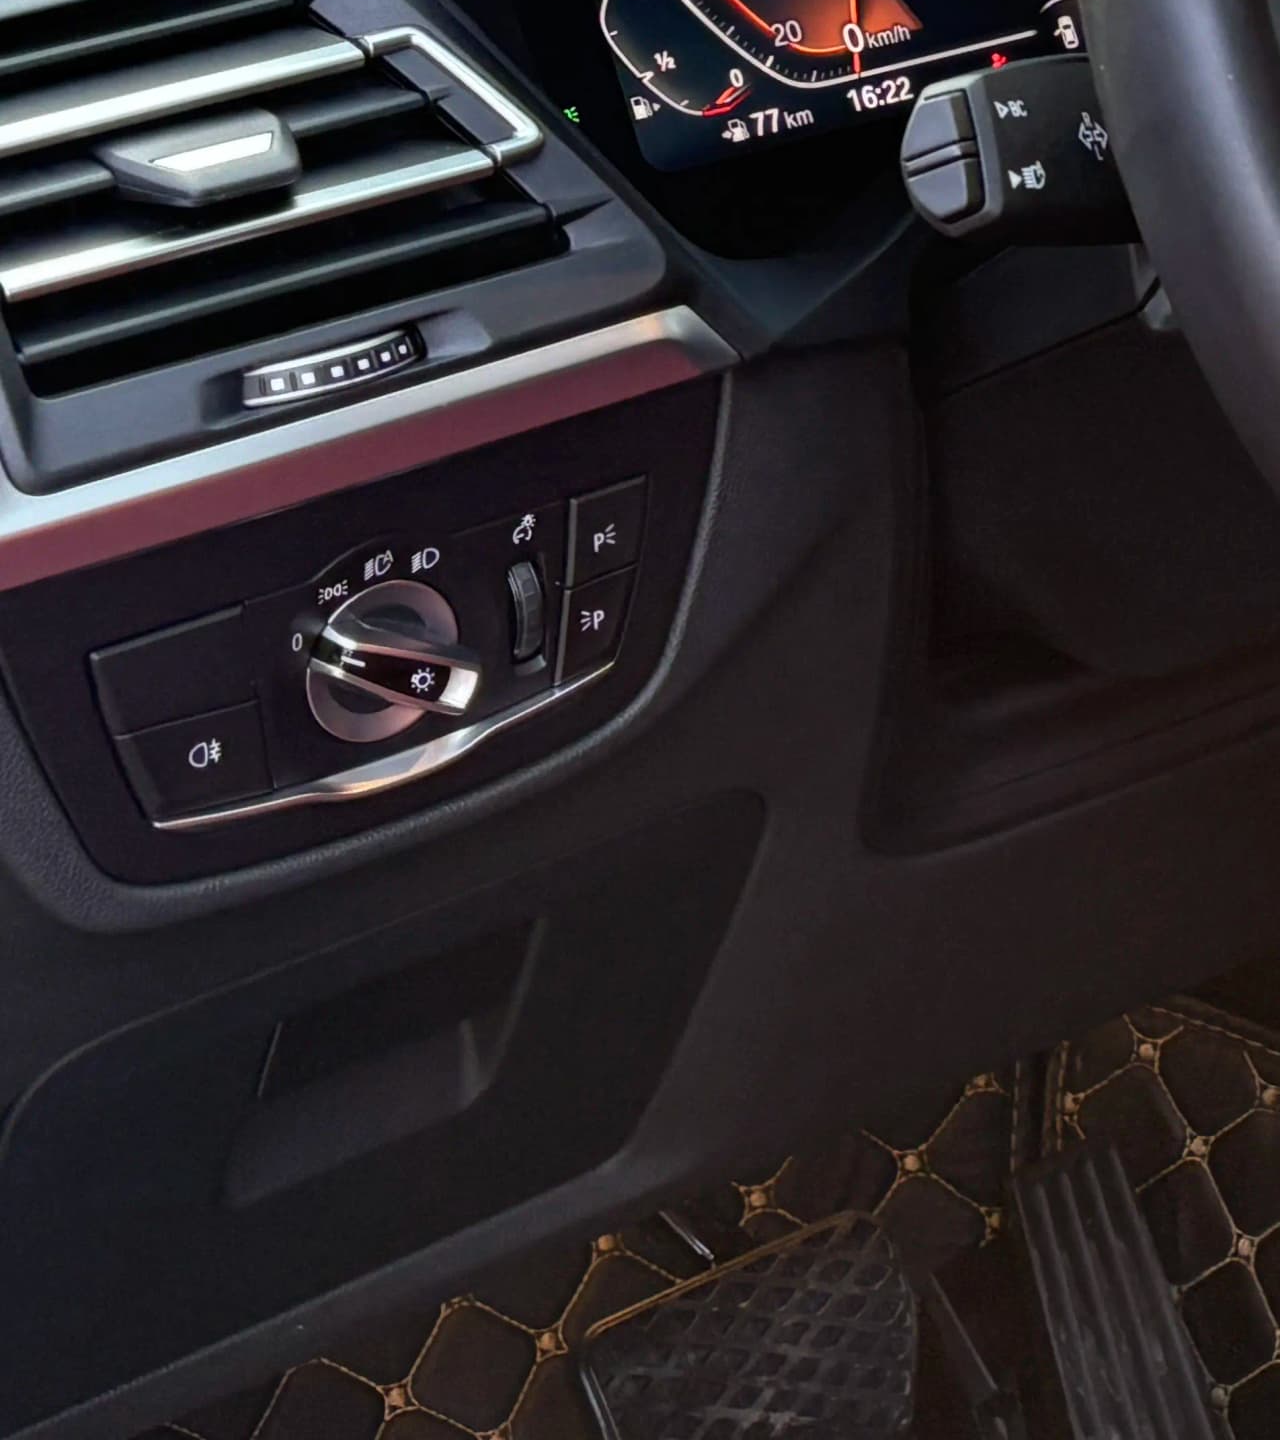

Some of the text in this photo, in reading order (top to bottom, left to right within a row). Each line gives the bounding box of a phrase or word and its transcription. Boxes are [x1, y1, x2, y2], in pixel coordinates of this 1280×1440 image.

[771, 19, 803, 45] 20
[842, 24, 911, 54] 0 km/h
[729, 68, 744, 87] 0
[846, 77, 915, 111] 16:22
[749, 107, 815, 136] 77 km
[1007, 99, 1028, 118] BC
